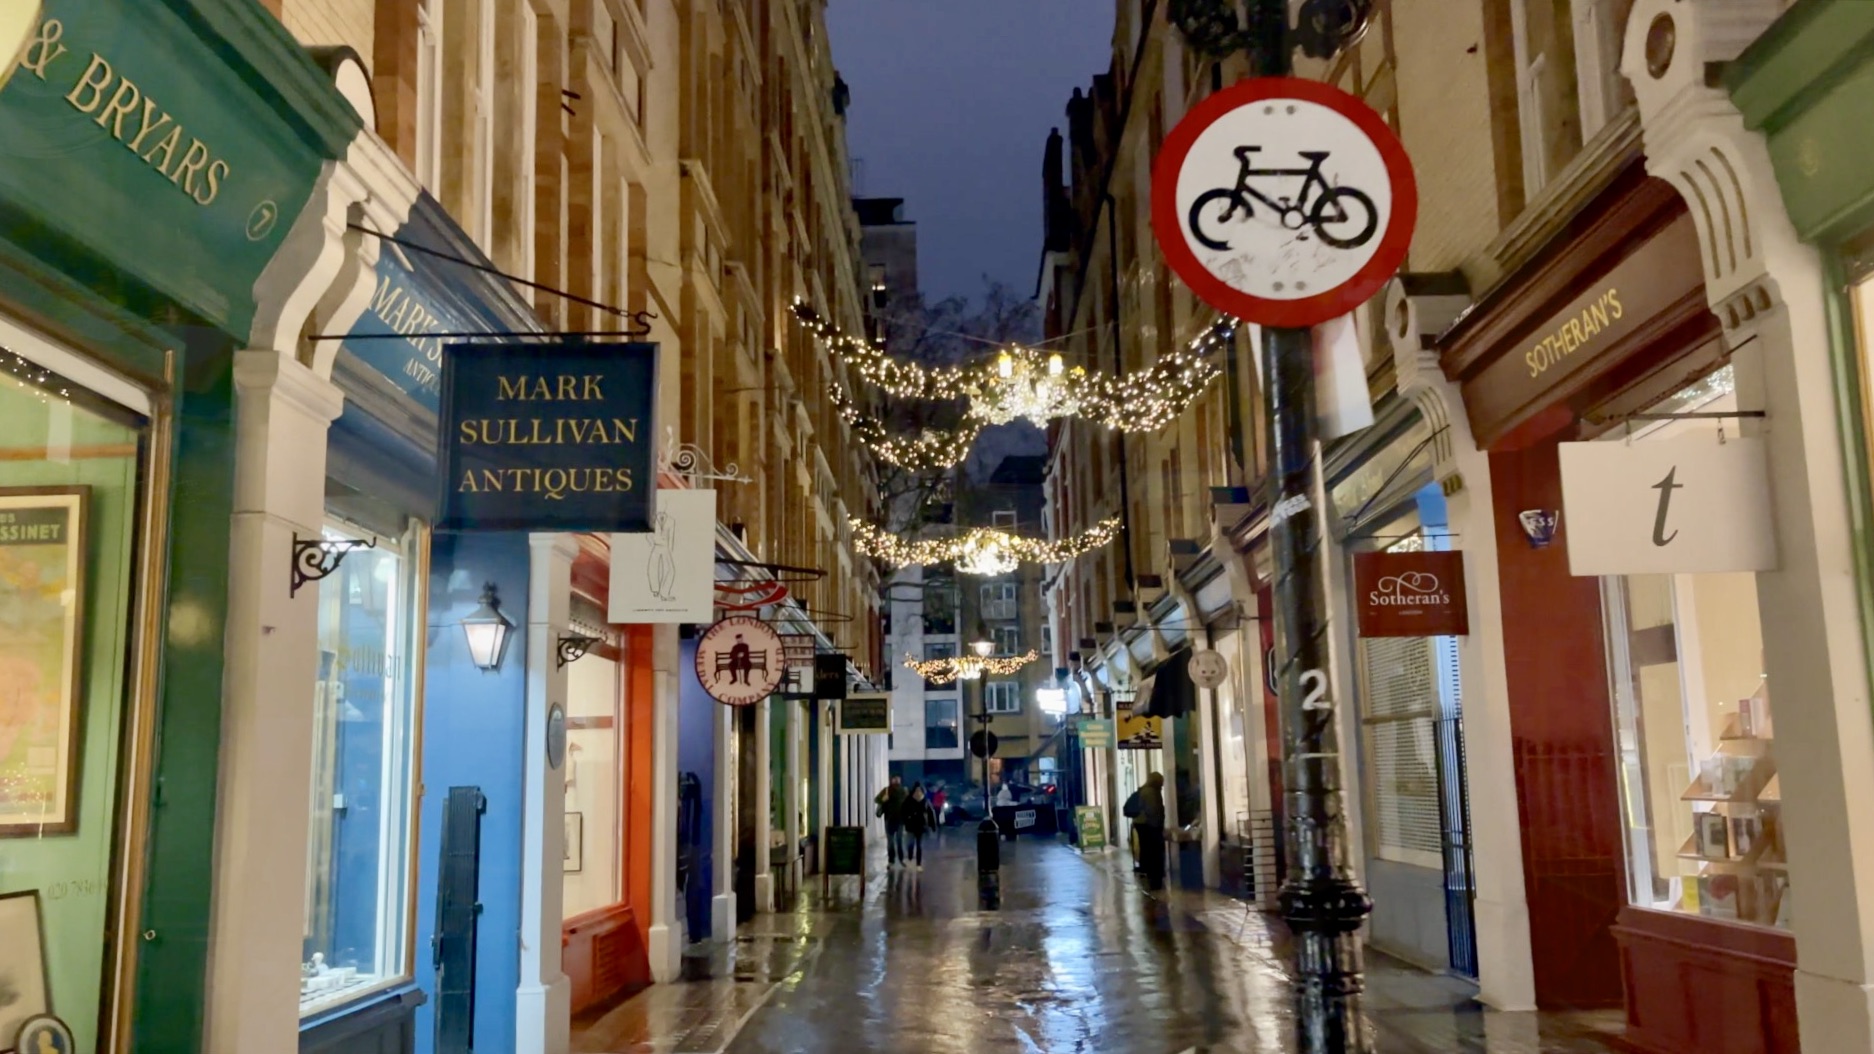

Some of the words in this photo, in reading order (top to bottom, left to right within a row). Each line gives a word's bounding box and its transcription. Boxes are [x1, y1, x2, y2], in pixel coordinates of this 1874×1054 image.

[19, 19, 67, 81] &
[64, 52, 230, 206] BRYARS
[368, 275, 439, 352] MARK
[1525, 288, 1622, 378] SOTHERAN'S
[497, 375, 604, 401] MARK
[459, 418, 639, 446] SULLIVAN
[458, 468, 632, 500] ANTIQUES
[1651, 465, 1684, 547] t
[1369, 581, 1451, 606] Sotheran's
[706, 623, 725, 641] THE
[729, 616, 777, 640] LONDON
[718, 681, 776, 706] COMPANY
[1299, 669, 1332, 711] 2
